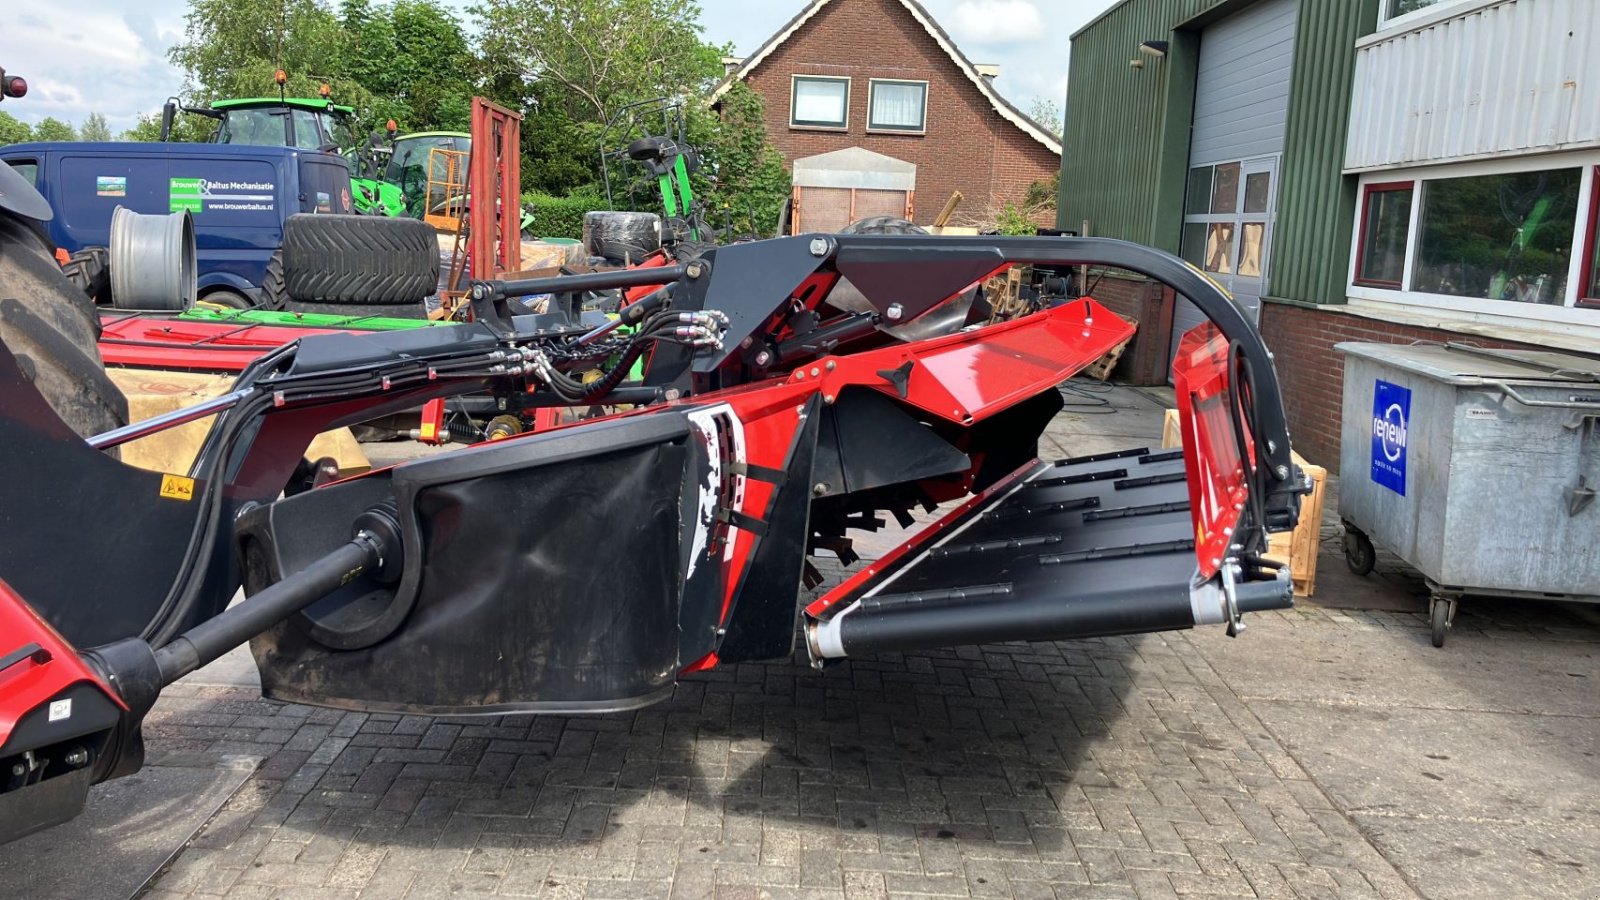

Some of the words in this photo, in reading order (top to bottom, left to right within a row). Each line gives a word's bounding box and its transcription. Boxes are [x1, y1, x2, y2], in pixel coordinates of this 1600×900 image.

[207, 181, 229, 190] Baltus
[230, 182, 274, 190] Mechanisatie
[208, 203, 274, 211] www.brouwerbaltus.nl
[1373, 417, 1407, 448] renewi
